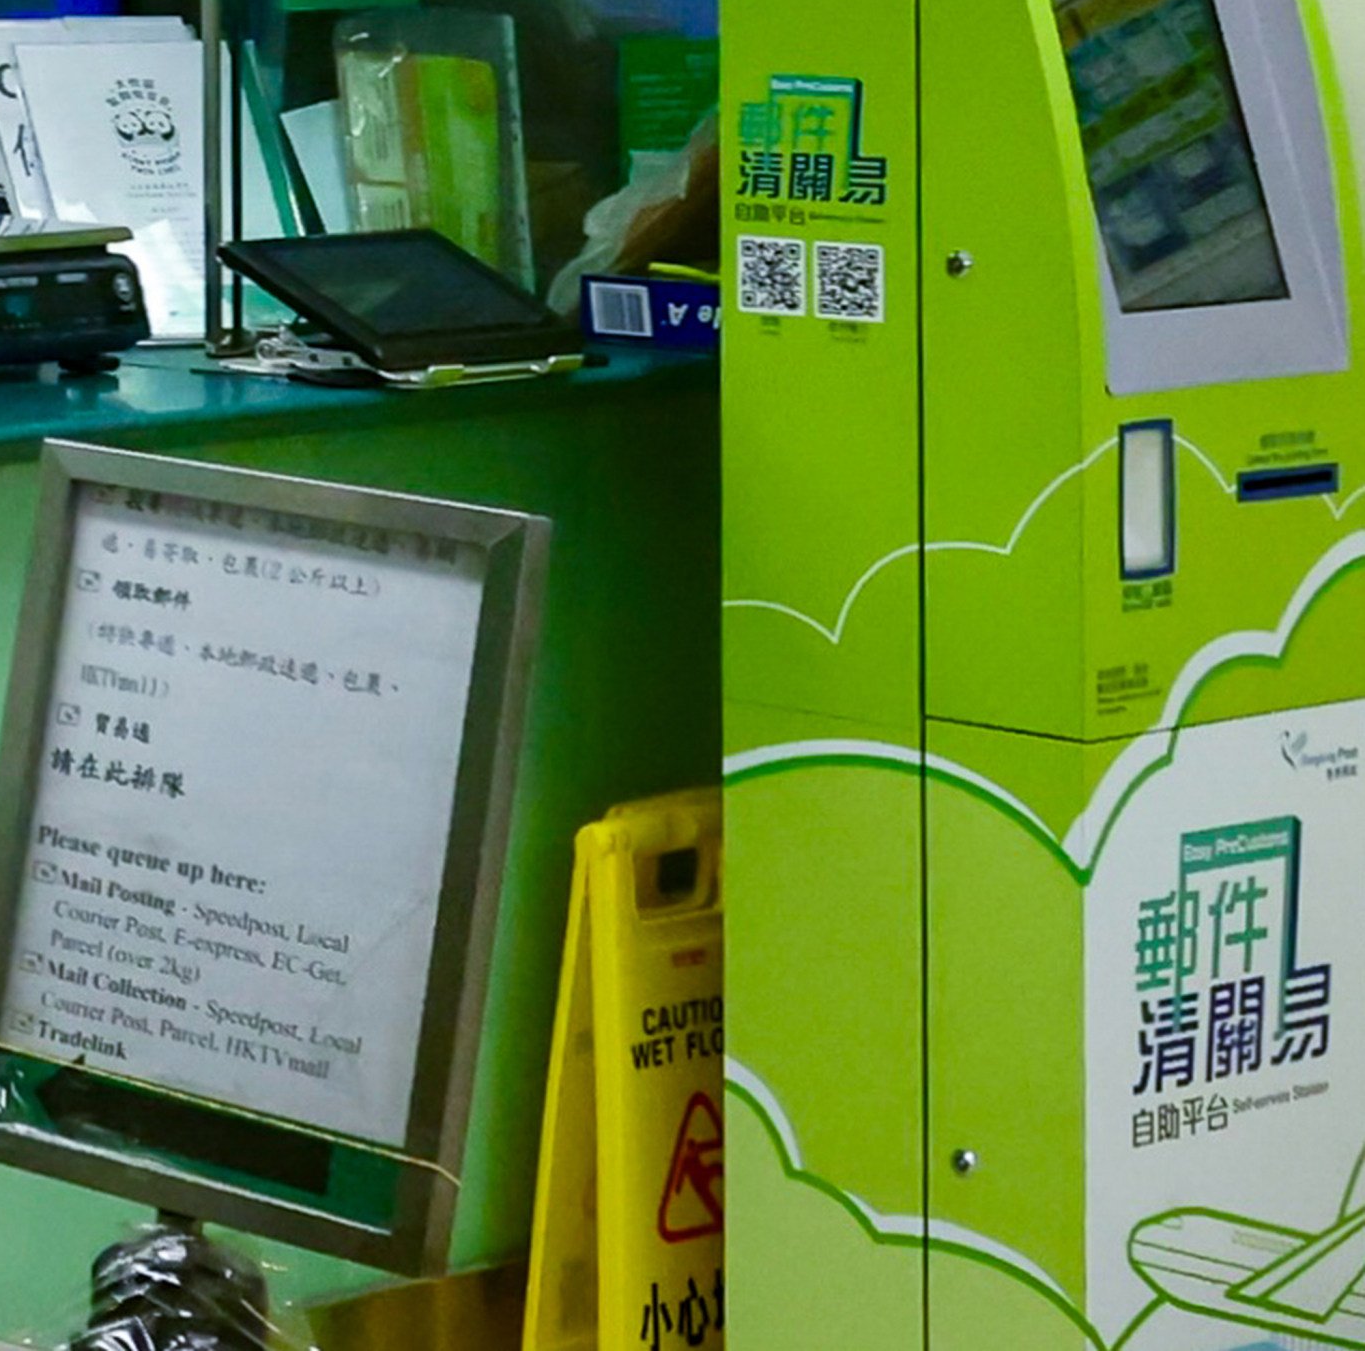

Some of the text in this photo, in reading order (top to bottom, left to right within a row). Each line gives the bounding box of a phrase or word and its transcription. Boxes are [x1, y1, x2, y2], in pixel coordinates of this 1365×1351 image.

[737, 150, 887, 205] 清關易
[50, 747, 185, 799] 請在此排隊
[38, 824, 266, 894] Please queue up here:
[54, 900, 120, 929] Courier
[61, 869, 102, 896] Mail
[107, 880, 176, 916] Posting
[193, 903, 290, 941] Speedpost,
[297, 924, 349, 954] Local
[1136, 876, 1268, 991] 郵件
[51, 929, 103, 957] Parcel
[159, 956, 201, 985] 2kg)
[41, 991, 106, 1022] Courier
[226, 1036, 331, 1079] HKTVmall
[48, 960, 88, 986] Mail
[93, 973, 187, 1011] Collection
[309, 1026, 362, 1054] Local
[642, 995, 723, 1036] CAUTIO
[1132, 963, 1331, 1095] 清關易
[38, 1019, 127, 1061] Tradelink
[632, 1027, 723, 1070] WET FLO
[1132, 1093, 1229, 1148] 自助平台
[641, 1269, 724, 1351] 小心
